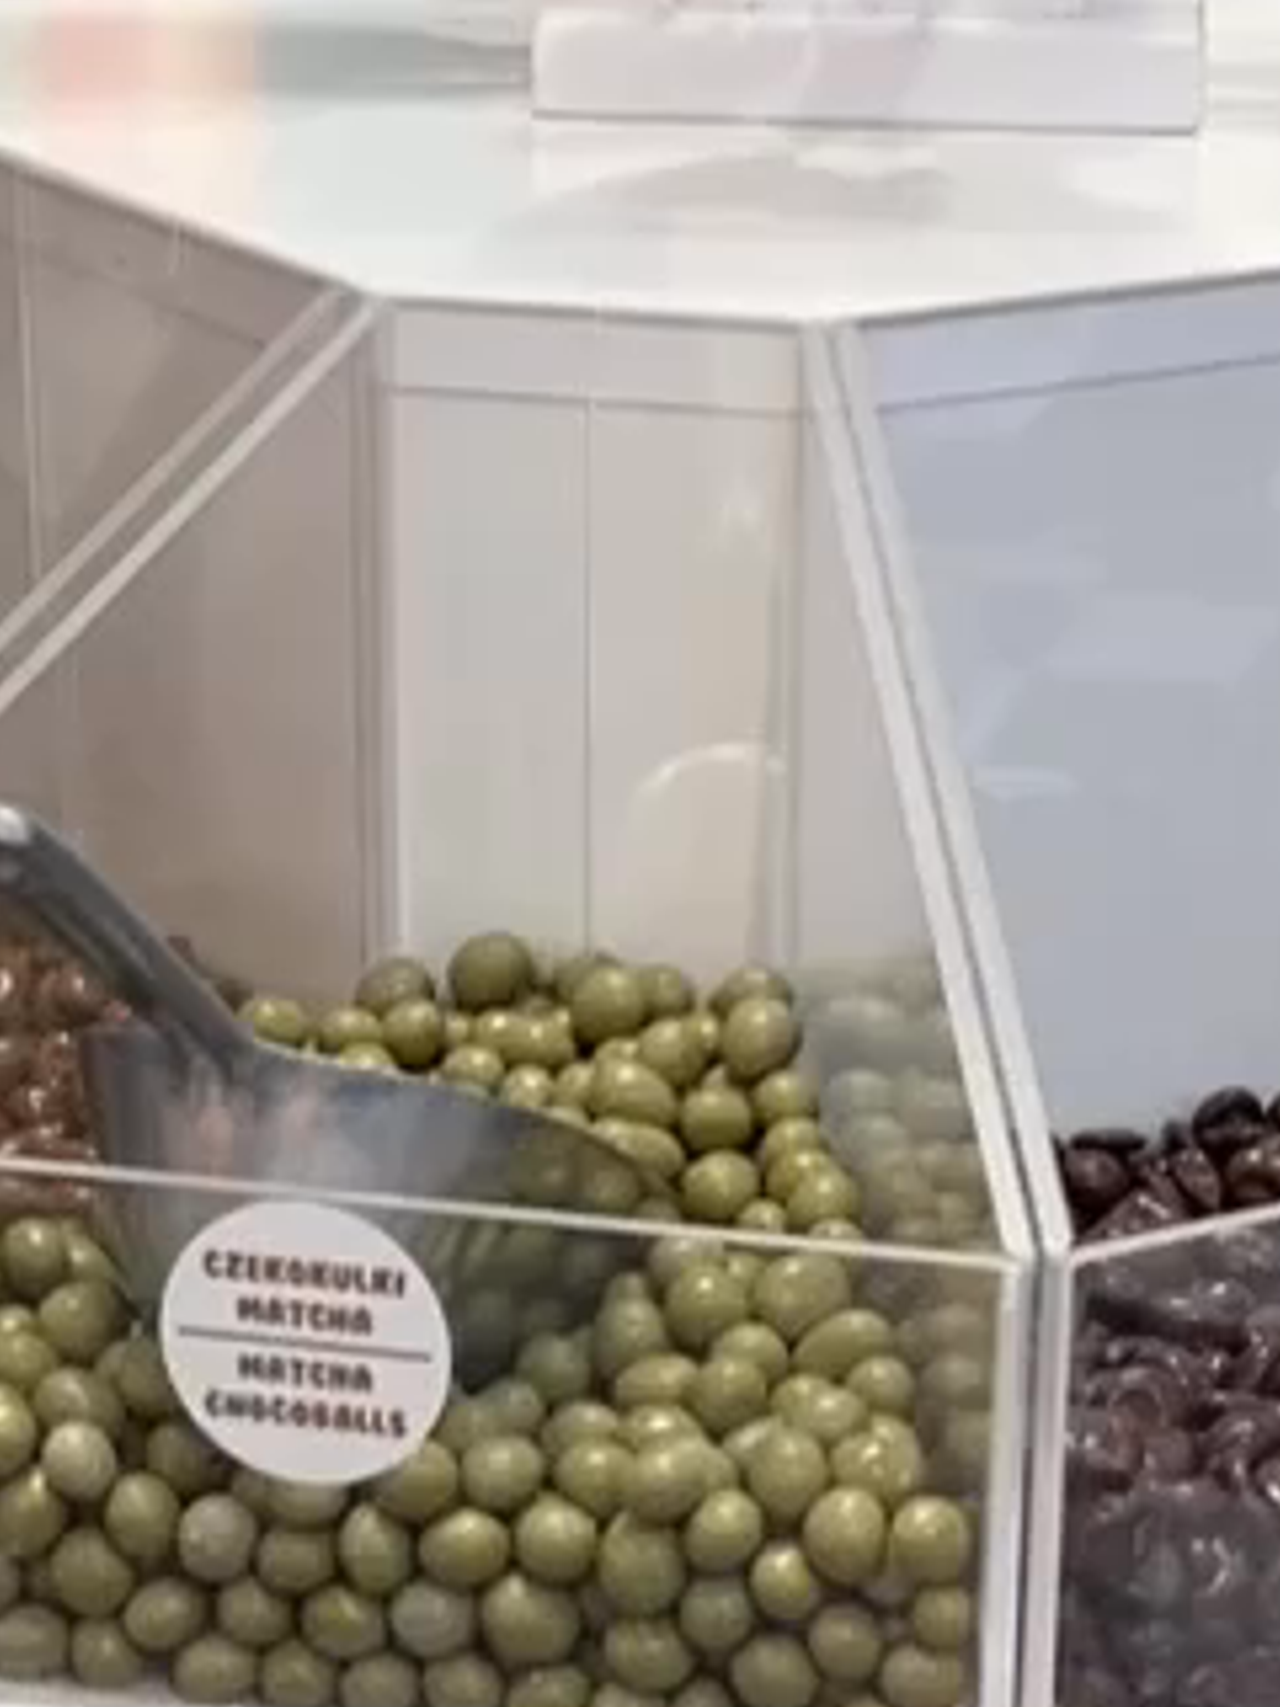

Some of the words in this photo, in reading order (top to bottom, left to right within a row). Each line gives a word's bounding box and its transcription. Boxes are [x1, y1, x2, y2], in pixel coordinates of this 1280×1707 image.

[237, 1297, 374, 1336] MATCHA
[237, 1354, 375, 1394] MATCHA
[205, 1393, 408, 1438] CHOCOBALLS
